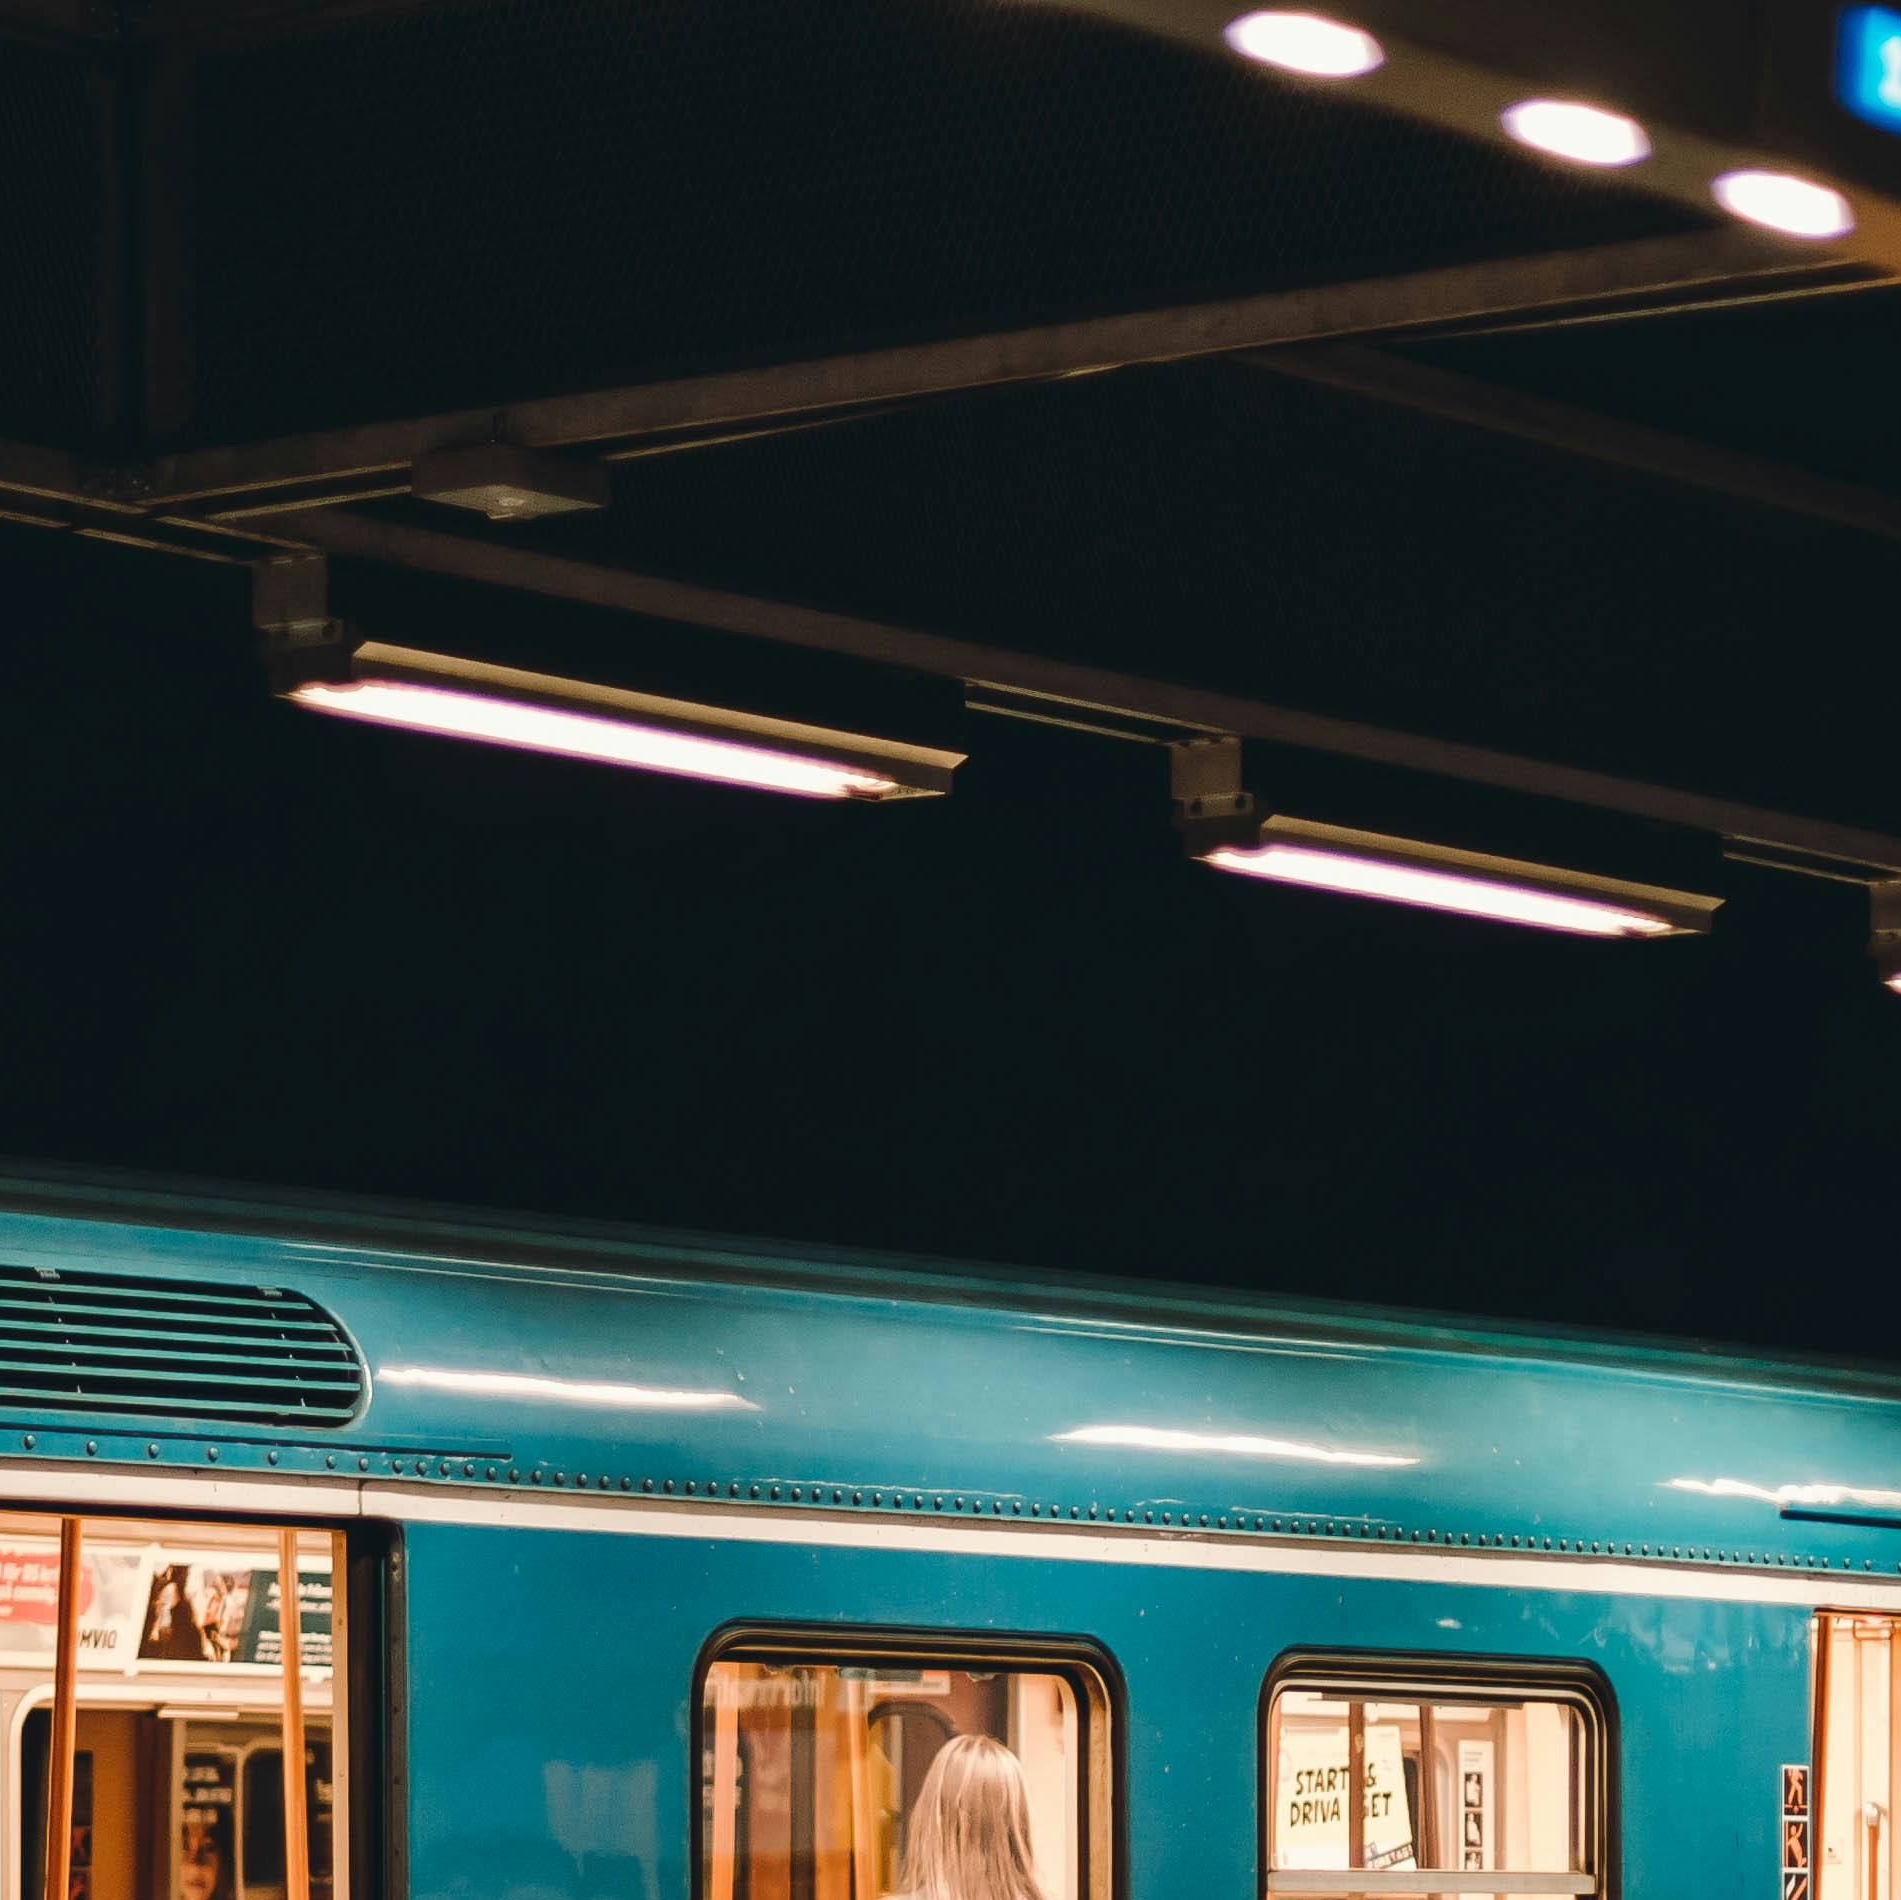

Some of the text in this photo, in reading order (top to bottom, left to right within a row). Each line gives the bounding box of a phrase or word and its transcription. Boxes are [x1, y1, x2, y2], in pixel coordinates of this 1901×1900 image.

[78, 1629, 118, 1649] MVIQ
[1295, 1766, 1350, 1795] START
[1290, 1797, 1341, 1829] DRIVA
